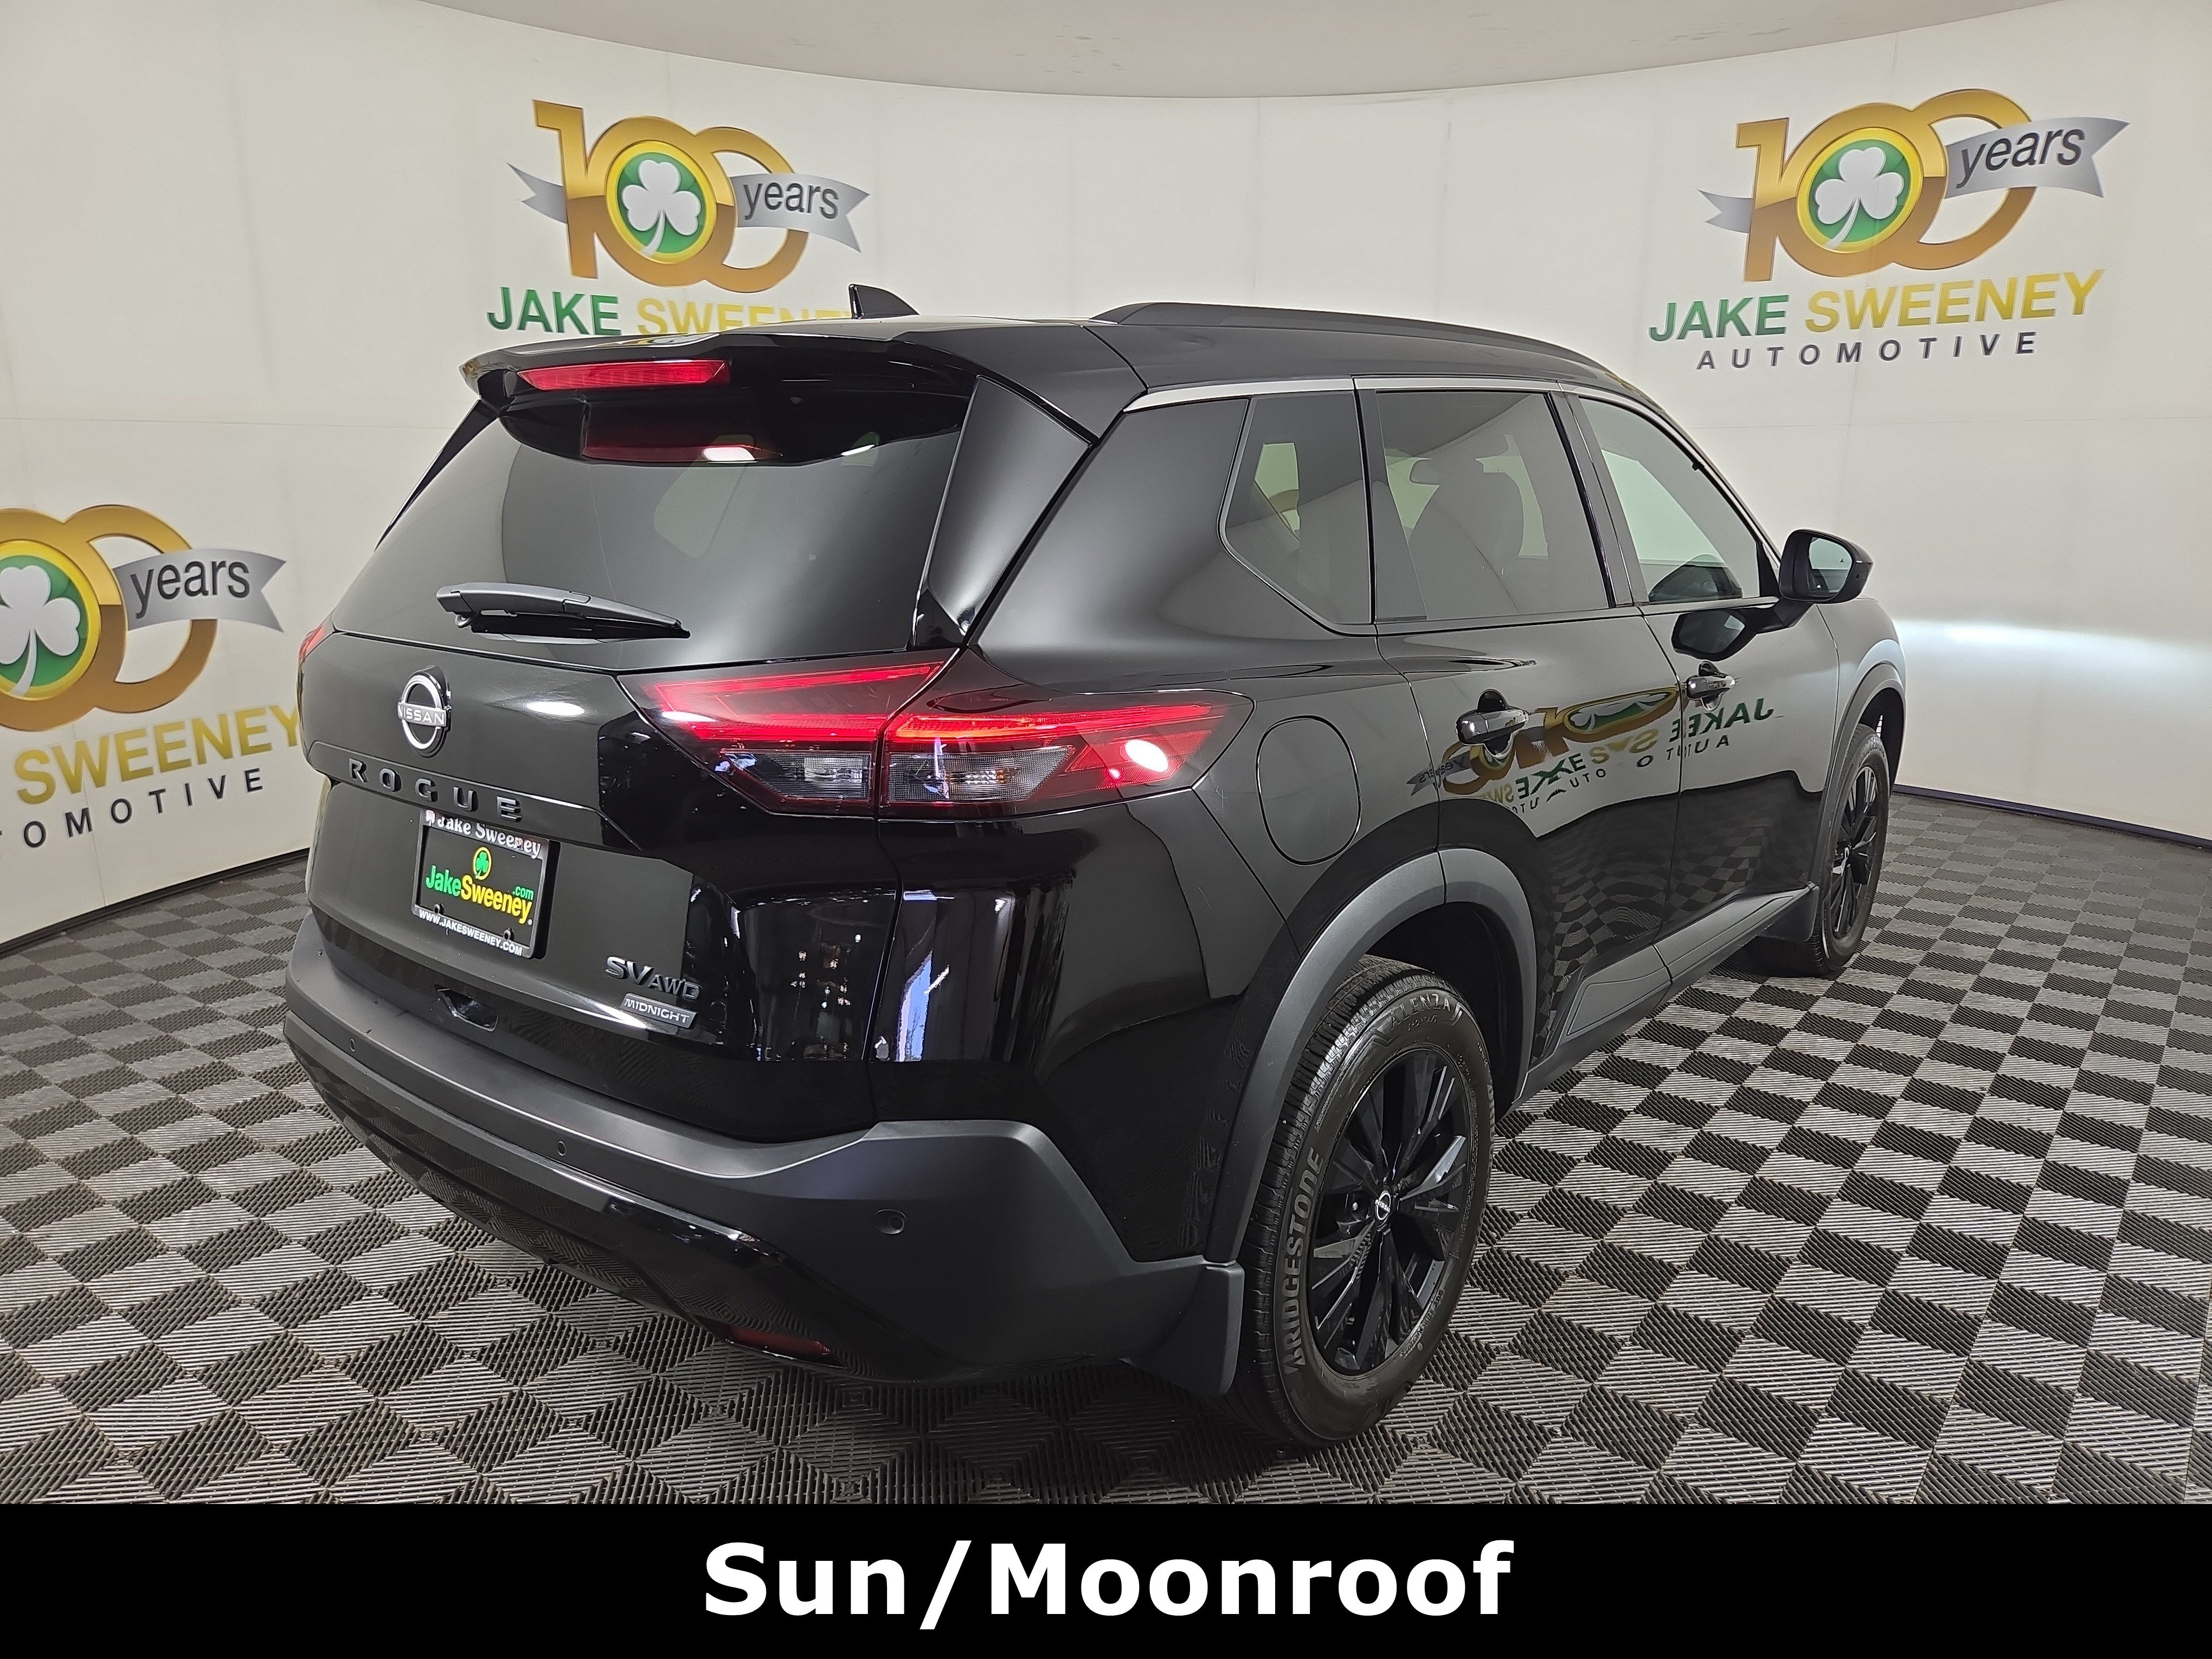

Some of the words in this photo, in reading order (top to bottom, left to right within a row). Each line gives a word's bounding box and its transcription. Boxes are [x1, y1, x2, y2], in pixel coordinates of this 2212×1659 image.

[1956, 127, 2085, 189] years
[743, 178, 839, 220] years
[487, 286, 622, 336] JAKE
[1649, 294, 1790, 343] JAKE
[1804, 268, 2106, 333] SWEENEY
[1696, 331, 2037, 370] AUTOMOTIVE
[130, 560, 250, 619] years
[398, 704, 444, 725] NISSAN
[14, 705, 298, 806] SWEENEY
[0, 768, 263, 848] OMOTIVE
[349, 758, 523, 822] ROGUE
[438, 817, 471, 835] Jake
[475, 822, 542, 859] Sweeney
[419, 909, 523, 956] WWW.JAKESWEENEY.COM
[605, 956, 654, 986] SV
[647, 974, 702, 1000] AWD
[625, 998, 691, 1024] MIDNIGHT
[1282, 1147, 1323, 1374] BRIDGESTONE
